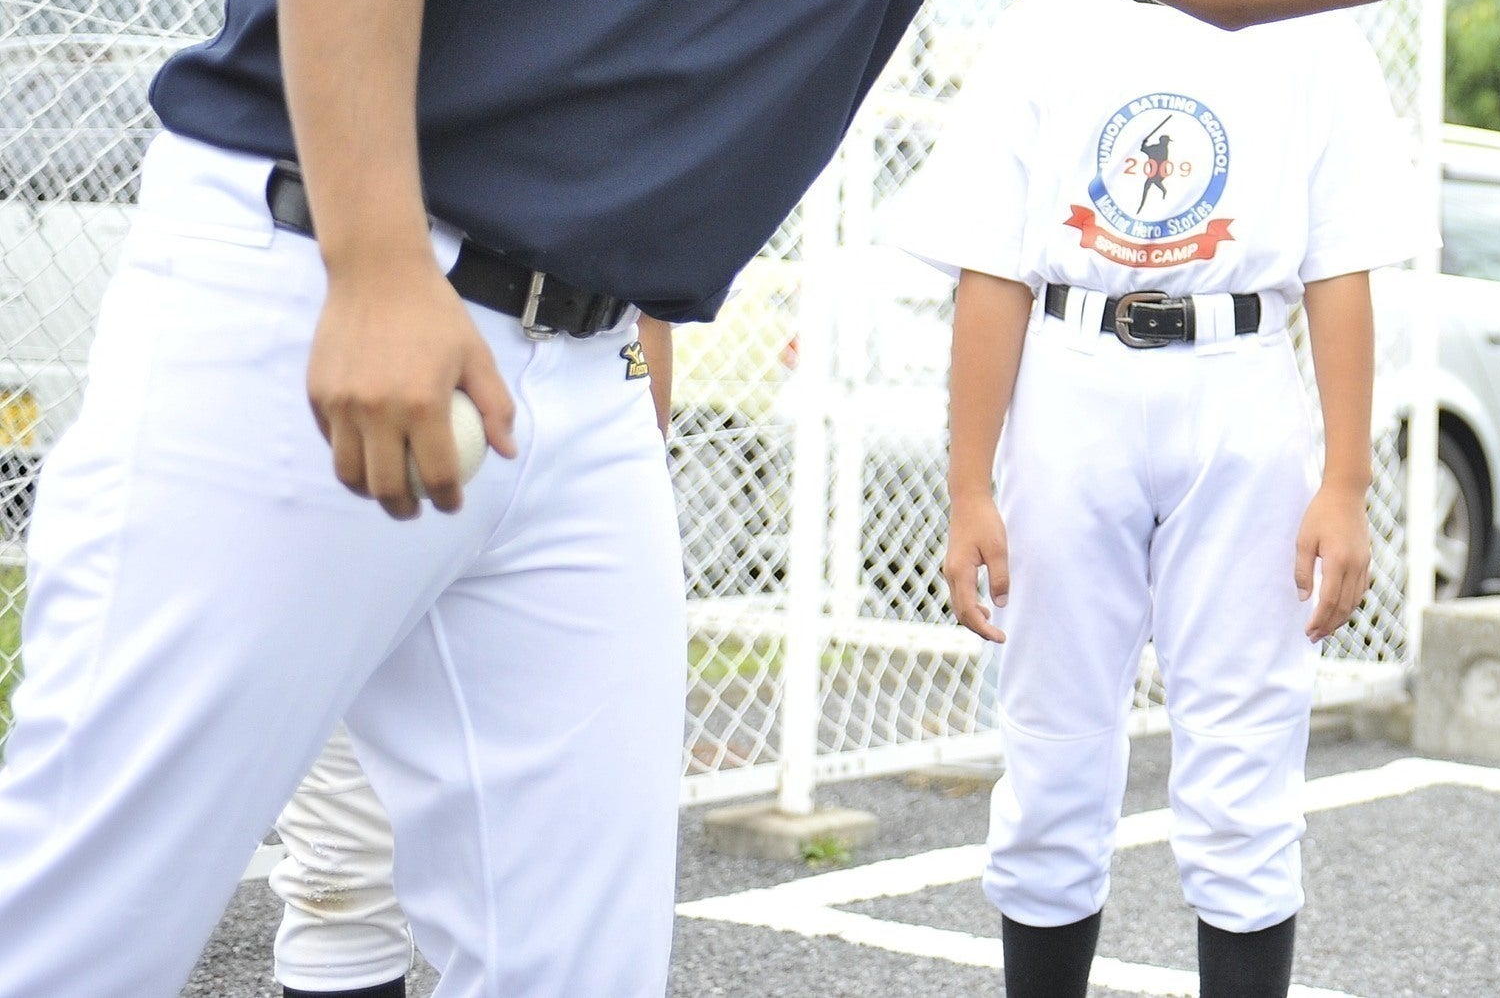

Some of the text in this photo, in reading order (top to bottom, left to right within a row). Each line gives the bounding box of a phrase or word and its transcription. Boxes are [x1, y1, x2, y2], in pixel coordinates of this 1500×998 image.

[1129, 94, 1198, 116] BATTING
[1199, 112, 1228, 176] SCHOOL
[1123, 157, 1192, 178] 2009
[1131, 221, 1162, 238] Hero
[1167, 201, 1214, 235] Stories
[1094, 234, 1199, 264] SPRING CAMP
